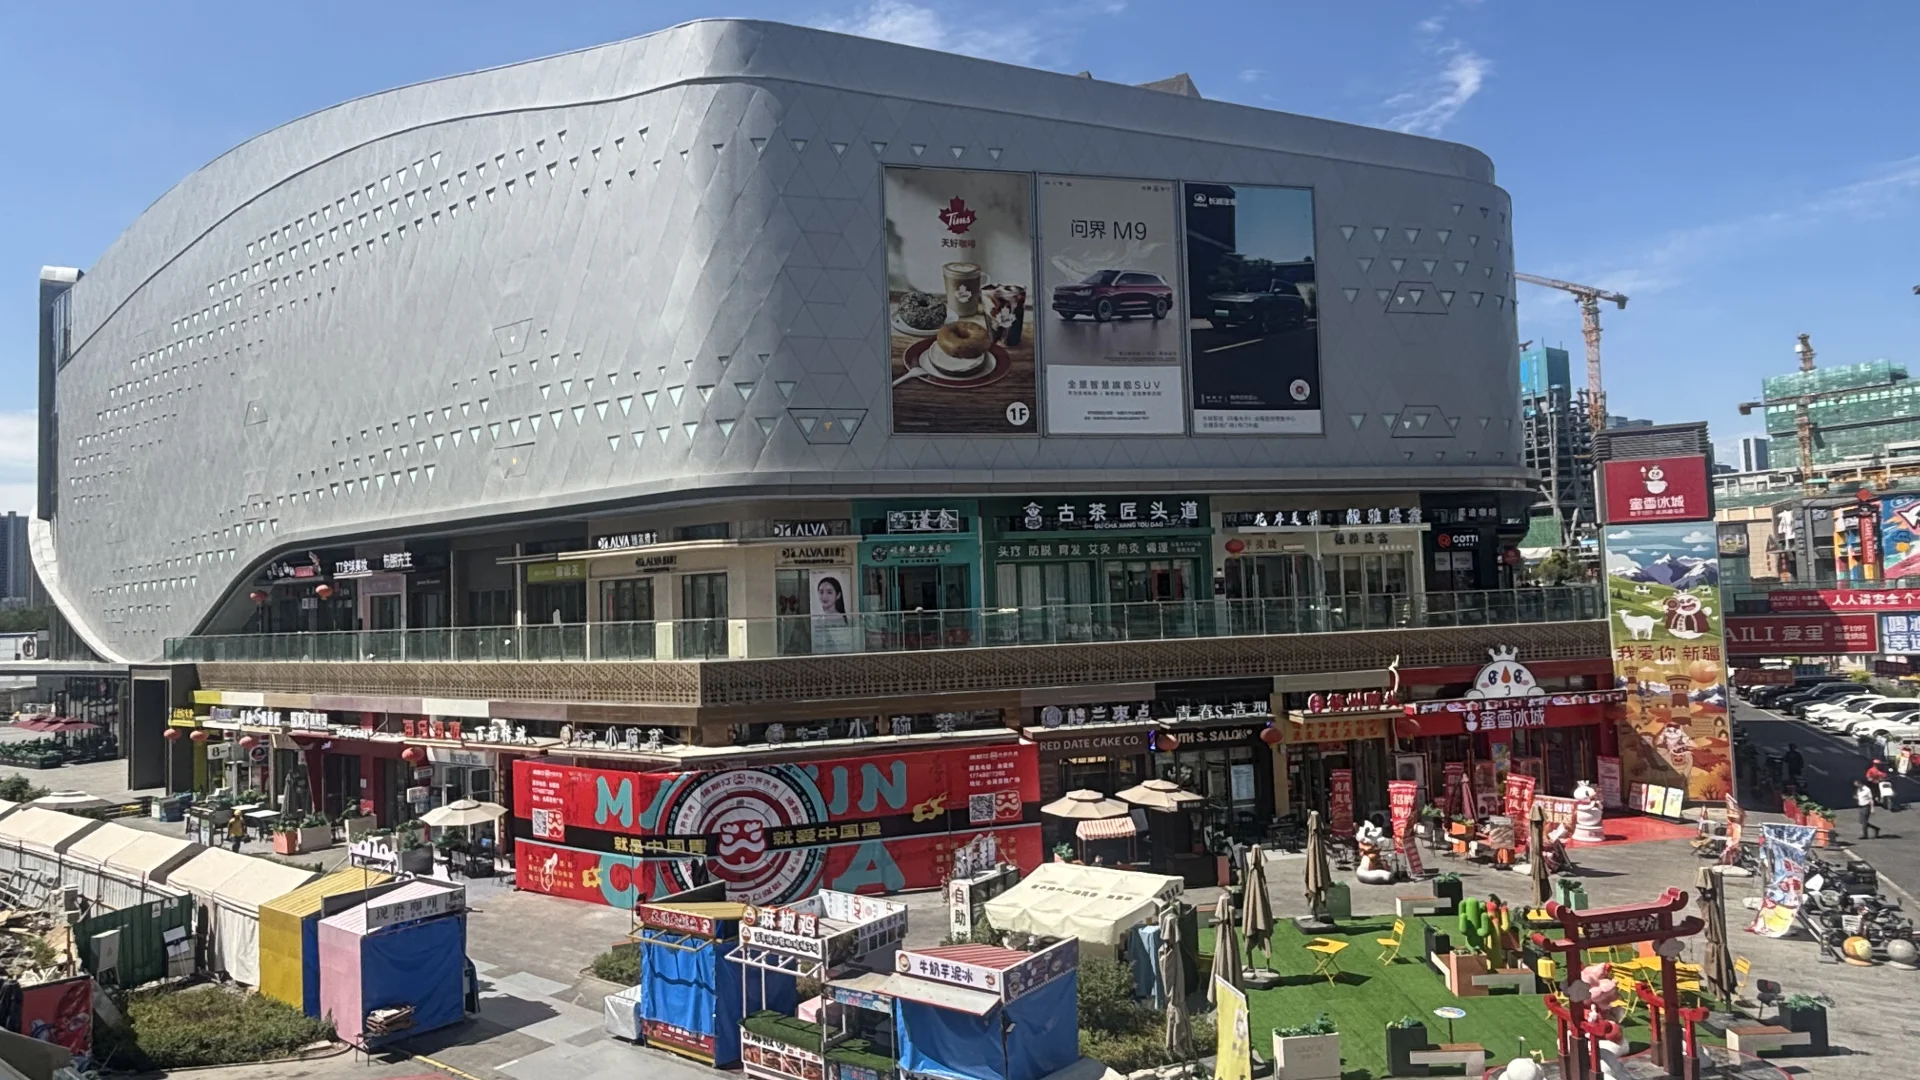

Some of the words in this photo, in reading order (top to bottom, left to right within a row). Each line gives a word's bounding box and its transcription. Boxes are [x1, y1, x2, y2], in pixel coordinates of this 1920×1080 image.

[946, 211, 976, 228] Tims
[1071, 219, 1107, 239] 问界
[1113, 221, 1147, 240] M9
[940, 238, 976, 249] 天好咖啡
[1009, 407, 1027, 421] 1F
[1058, 501, 1199, 523] 古茶匠头道
[1629, 495, 1684, 510] 蜜雪冰城
[1028, 545, 1052, 556] 防脱
[848, 712, 955, 737] 小碗菜
[1480, 708, 1545, 729] 蜜雪冰城
[1040, 737, 1061, 752] RED
[1063, 736, 1090, 750] DATE
[1093, 736, 1121, 749] CAKE
[1123, 734, 1142, 747] CO.
[773, 822, 881, 846] 就爱中国堡
[919, 960, 974, 984] 牛奶芋泥冰
